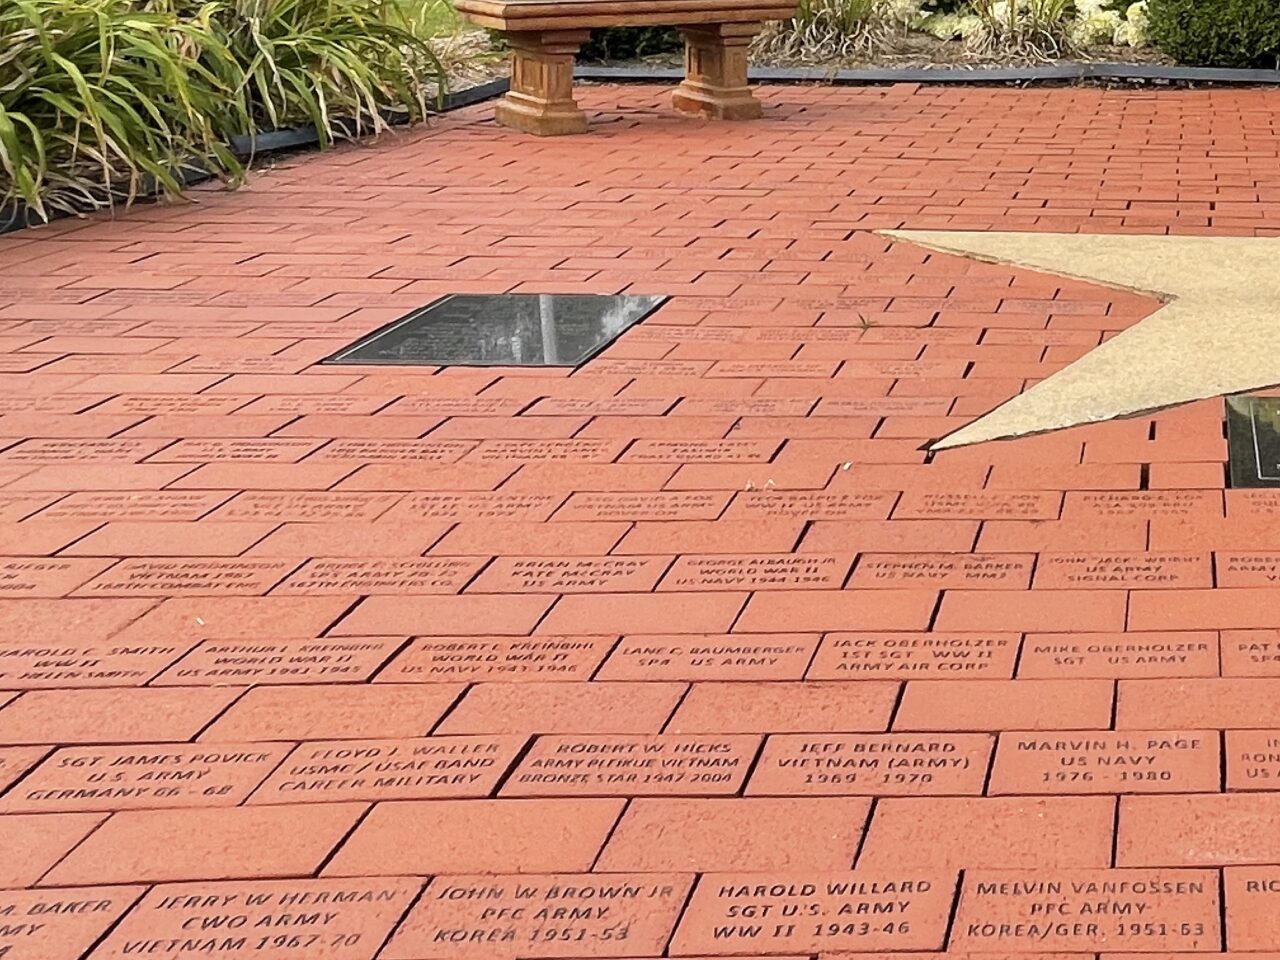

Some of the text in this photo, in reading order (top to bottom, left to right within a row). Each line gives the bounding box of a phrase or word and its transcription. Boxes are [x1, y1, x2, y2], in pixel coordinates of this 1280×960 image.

[1033, 644, 1081, 654] MIKE
[854, 741, 956, 754] BERNARD
[1016, 738, 1109, 750] MARVIN
[1146, 738, 1202, 750] PAGE
[777, 754, 971, 769] VIETNAM (ARMY)
[1061, 754, 1158, 766] US NAVY
[436, 886, 504, 900] JOHN
[547, 885, 642, 900] BROWN
[648, 886, 674, 898] JR
[718, 880, 932, 897] HAROLD WILLARD
[976, 881, 1205, 895] MELVIN VANFOSSEN
[27, 899, 114, 916] BAKER
[156, 894, 239, 910] JERRY
[281, 890, 397, 906] HERMAN
[480, 905, 610, 921] PFC ARMY
[726, 905, 773, 918] SGT
[839, 901, 910, 916] ARMY
[1030, 901, 1149, 916] PFC ARMY
[181, 912, 338, 930] CWO ARMY
[432, 928, 519, 943] KOREA
[712, 925, 762, 939] WW
[122, 938, 247, 954] VIETNAM
